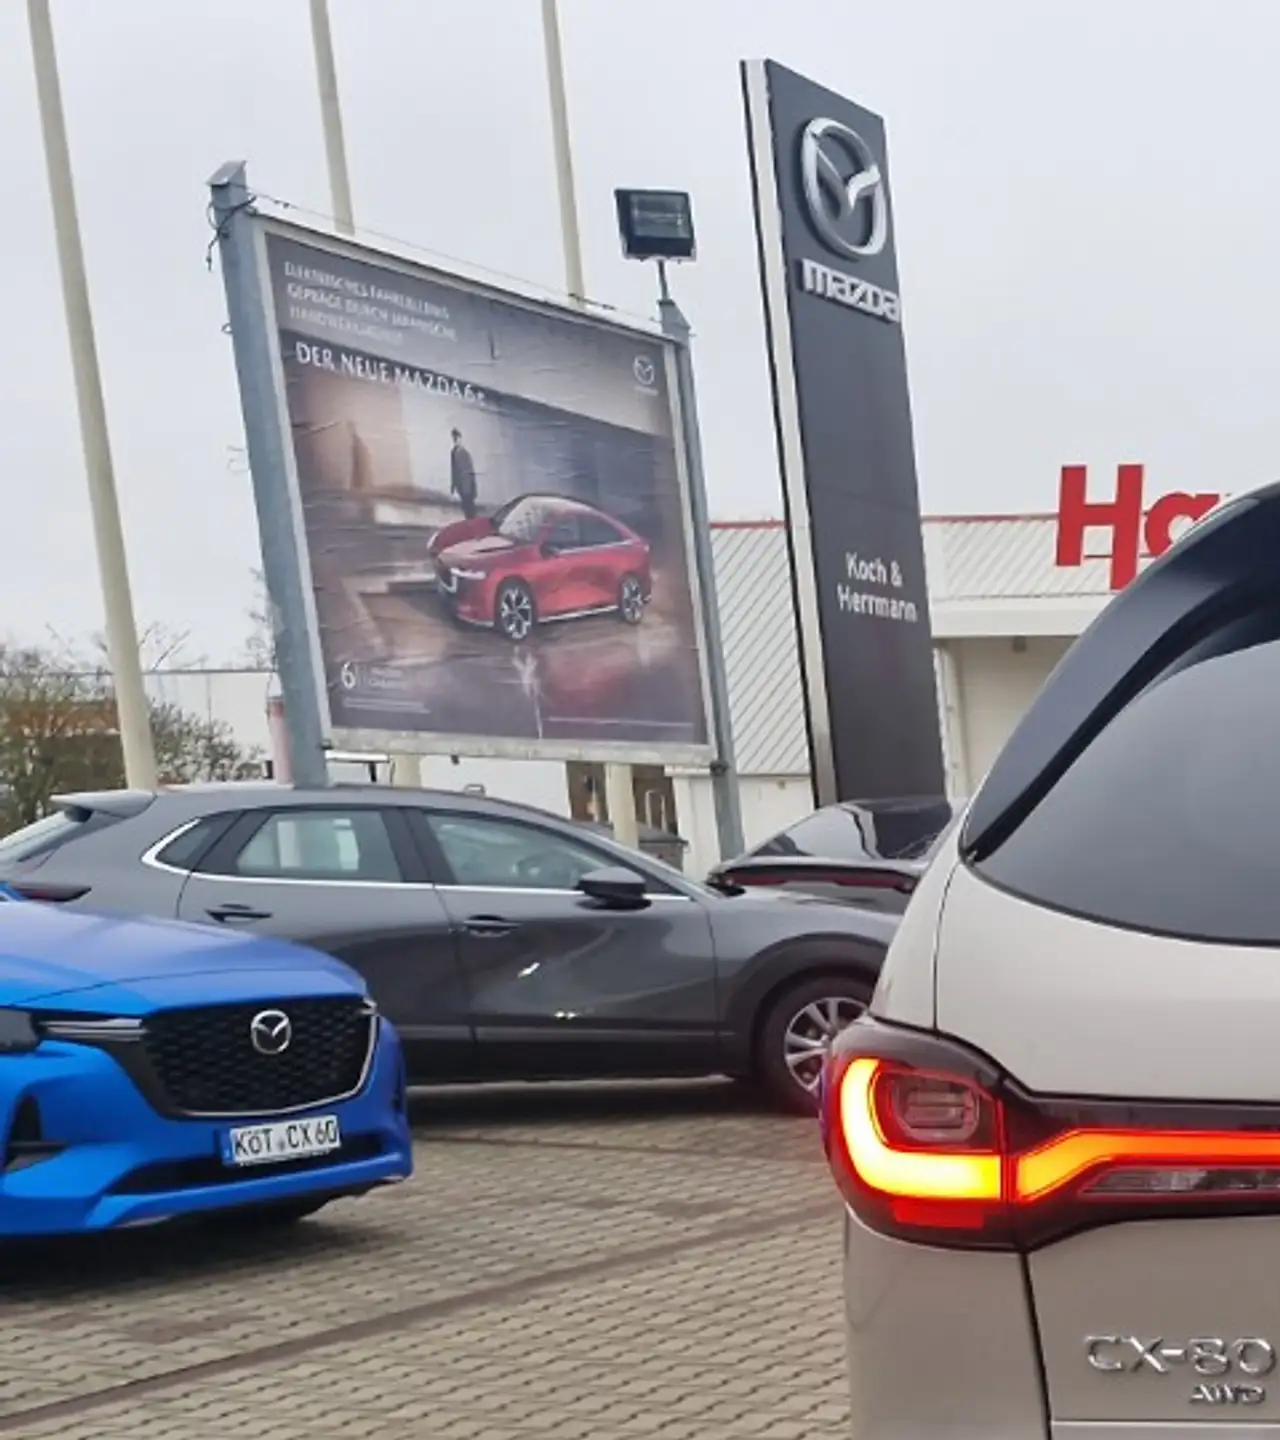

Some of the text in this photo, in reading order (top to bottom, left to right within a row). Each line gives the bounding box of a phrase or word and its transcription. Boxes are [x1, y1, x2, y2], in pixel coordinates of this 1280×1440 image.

[296, 341, 336, 372] DER
[340, 352, 391, 384] NEUE
[845, 551, 903, 588] Koch &
[836, 582, 918, 623] Herrmann
[1085, 1334, 1277, 1377] CX-80
